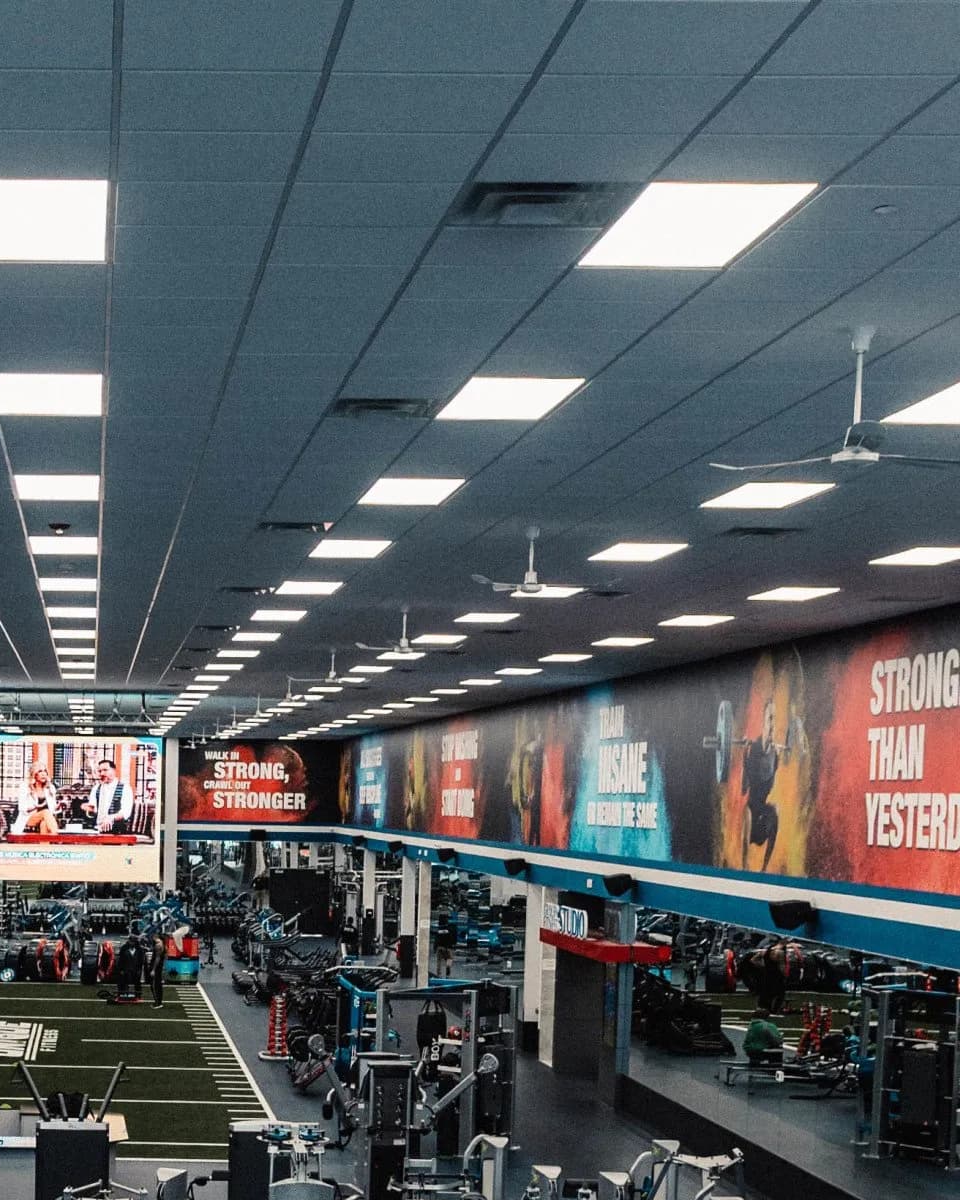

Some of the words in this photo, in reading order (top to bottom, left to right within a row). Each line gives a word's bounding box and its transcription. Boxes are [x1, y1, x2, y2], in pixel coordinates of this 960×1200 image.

[204, 751, 229, 760] WALK
[230, 751, 240, 760] IN
[867, 724, 926, 781] THAN
[213, 761, 290, 783] STRONG,
[598, 742, 648, 794] INSANE
[203, 780, 233, 789] CRAWL
[235, 781, 251, 790] OUT
[212, 791, 307, 810] STRONGER
[636, 802, 658, 829] SAME
[865, 792, 960, 851] YESTERD
